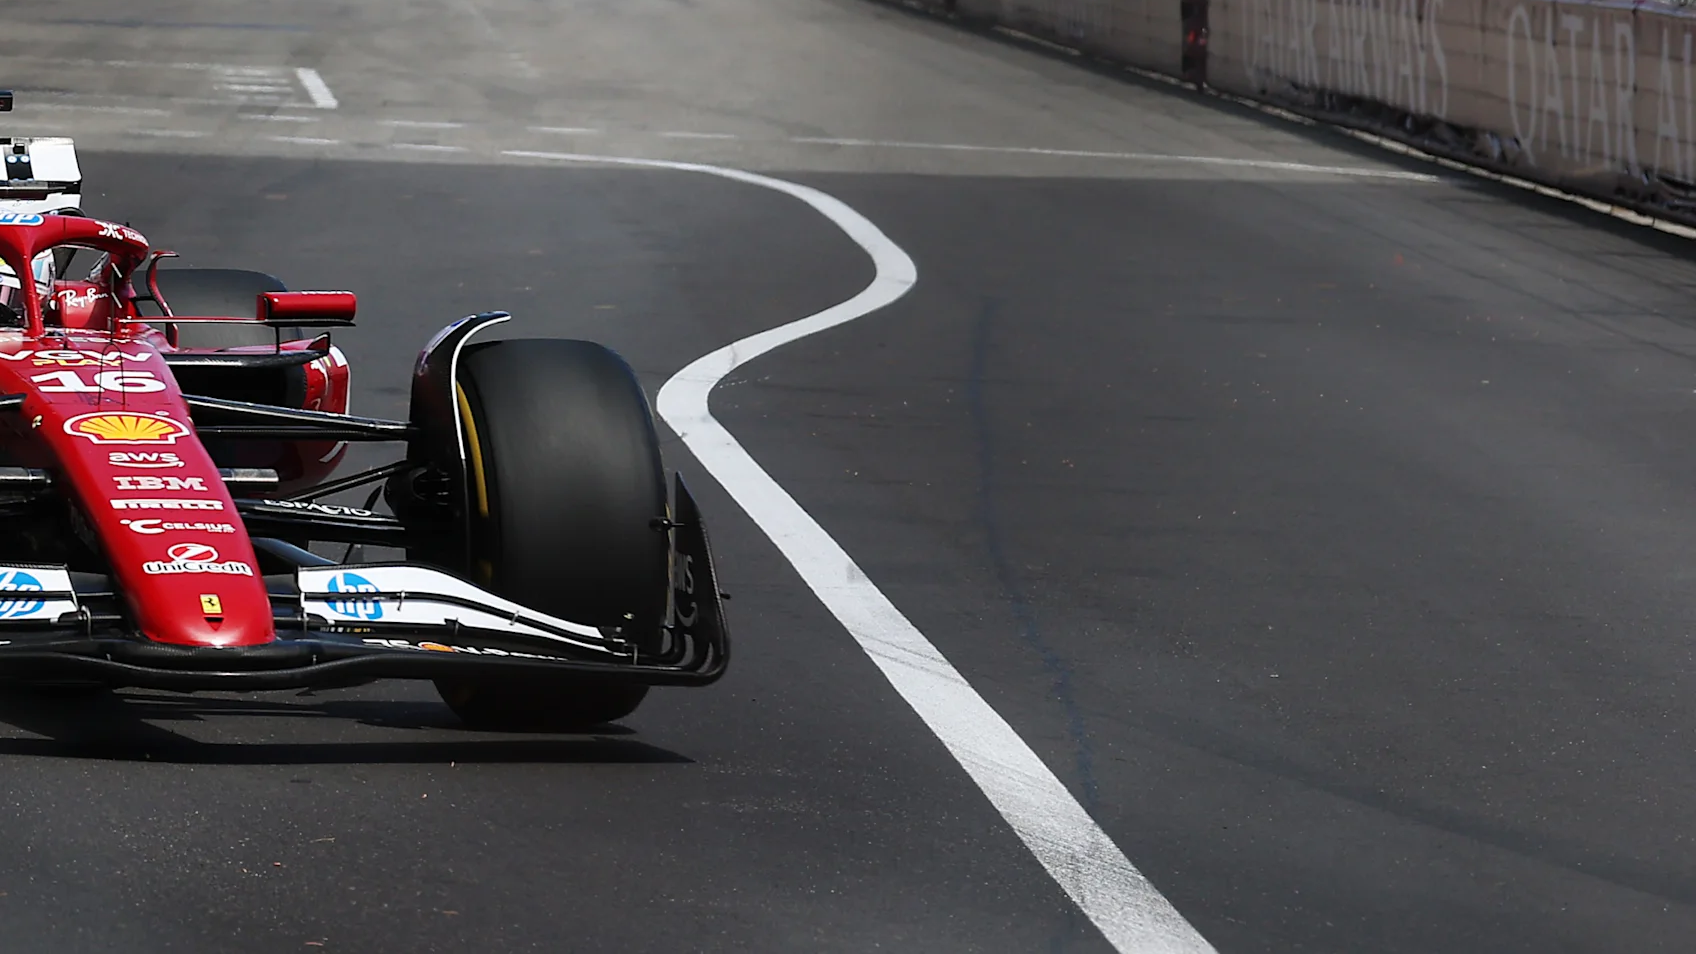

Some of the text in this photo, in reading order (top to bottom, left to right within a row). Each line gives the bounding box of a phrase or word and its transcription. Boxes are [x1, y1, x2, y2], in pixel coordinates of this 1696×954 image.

[1508, 3, 1642, 178] QATAR
[30, 370, 166, 393] 16
[109, 452, 181, 463] aws
[112, 476, 208, 491] IBM
[110, 498, 224, 510] PIRELLI
[145, 561, 250, 575] UniCredit
[327, 572, 382, 620] hp
